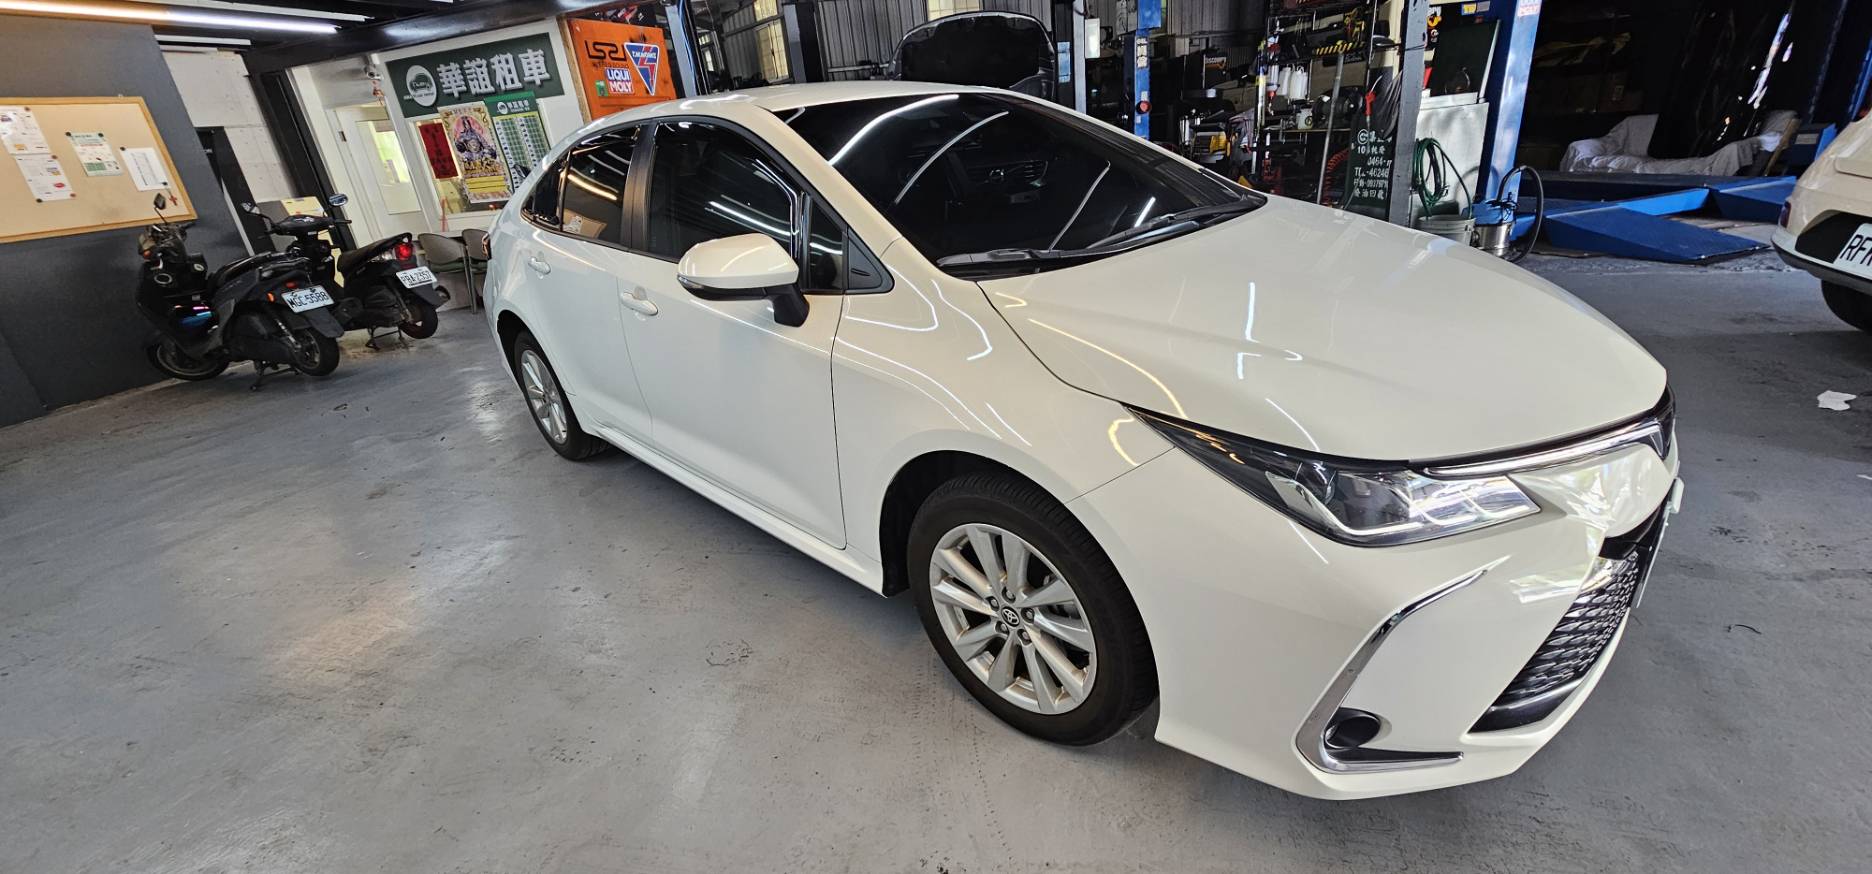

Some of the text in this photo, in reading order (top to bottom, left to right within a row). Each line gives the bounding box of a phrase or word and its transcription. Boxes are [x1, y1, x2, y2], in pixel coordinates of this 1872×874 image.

[436, 48, 551, 99] 華誼租車
[606, 68, 631, 81] LIQUI
[608, 80, 633, 93] MOLY
